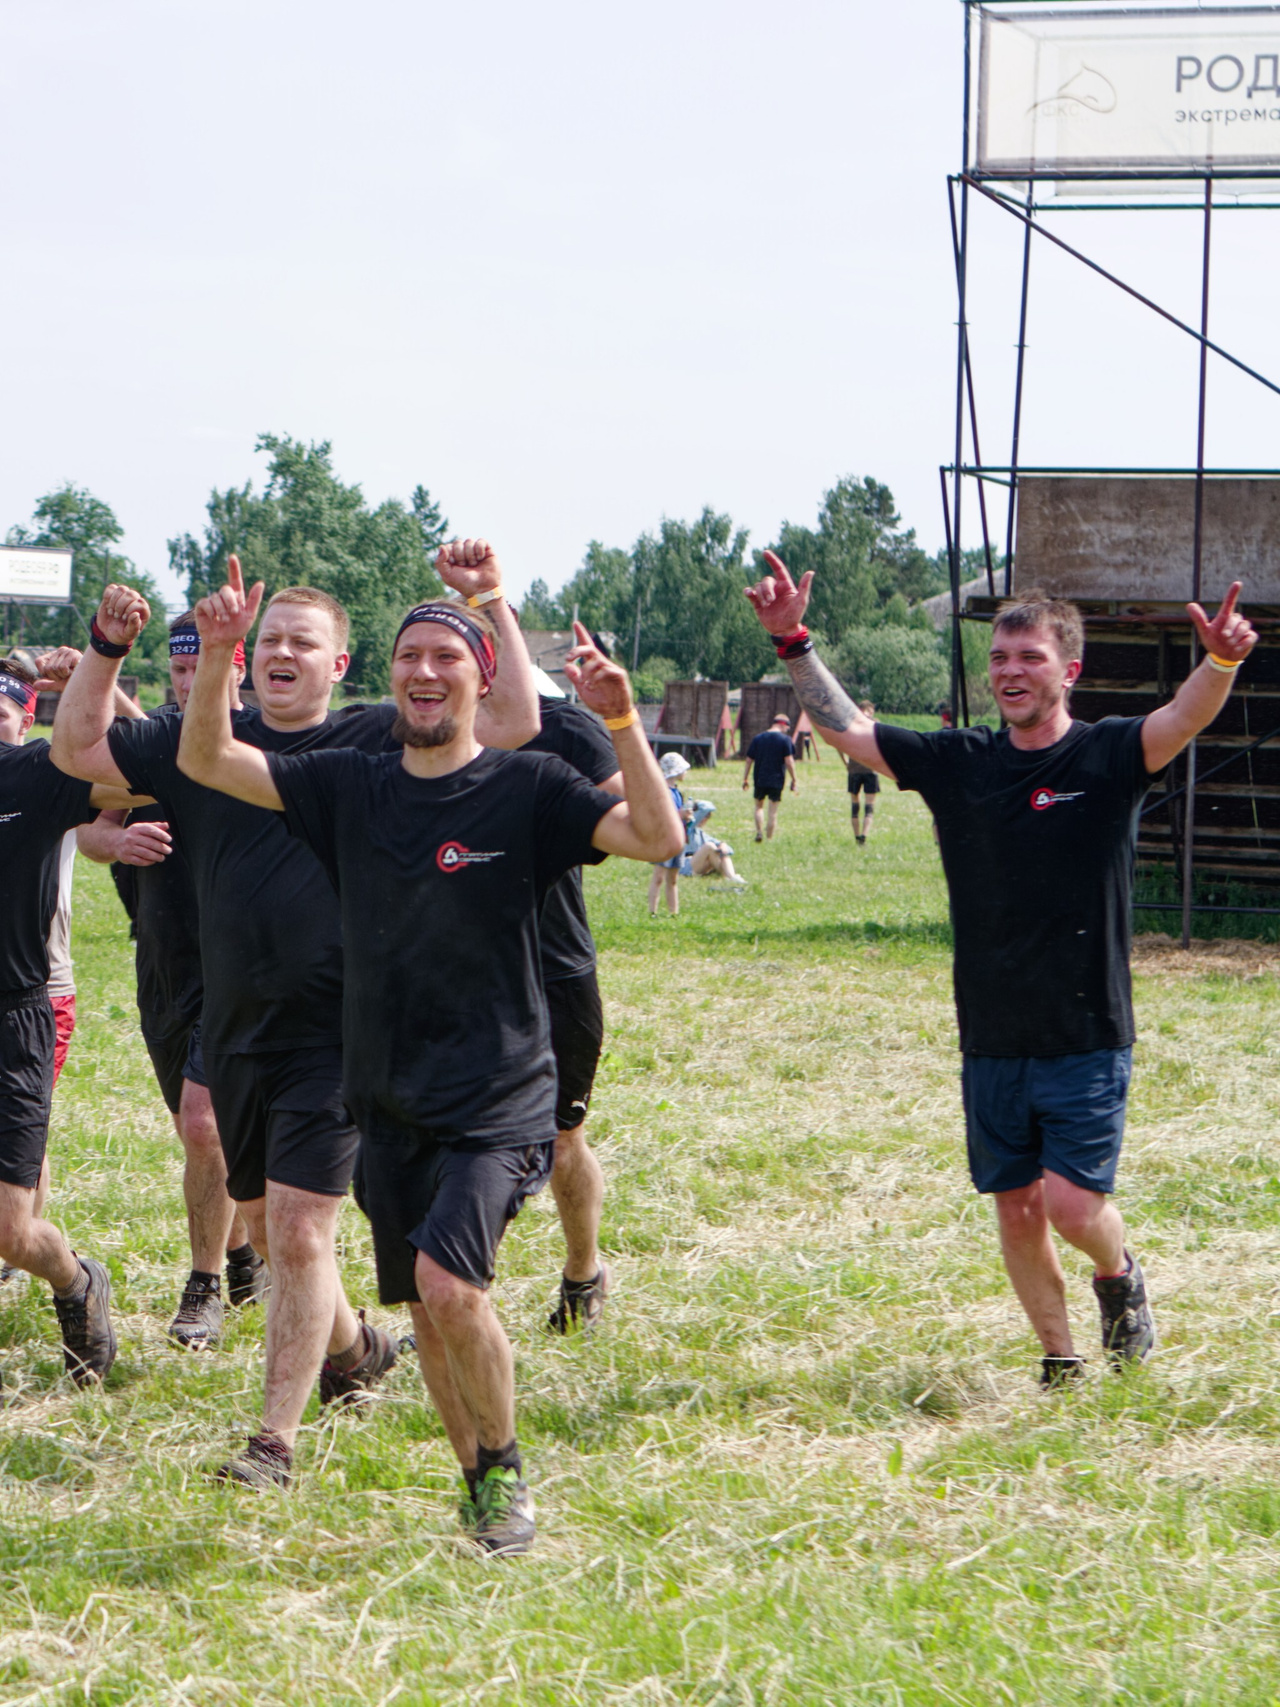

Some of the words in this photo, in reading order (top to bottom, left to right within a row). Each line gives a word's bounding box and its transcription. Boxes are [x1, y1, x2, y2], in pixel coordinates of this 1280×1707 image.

[1175, 54, 1280, 99] РОД
[1175, 108, 1280, 126] экстрема
[171, 645, 196, 654] 3247
[9, 680, 20, 689] 59
